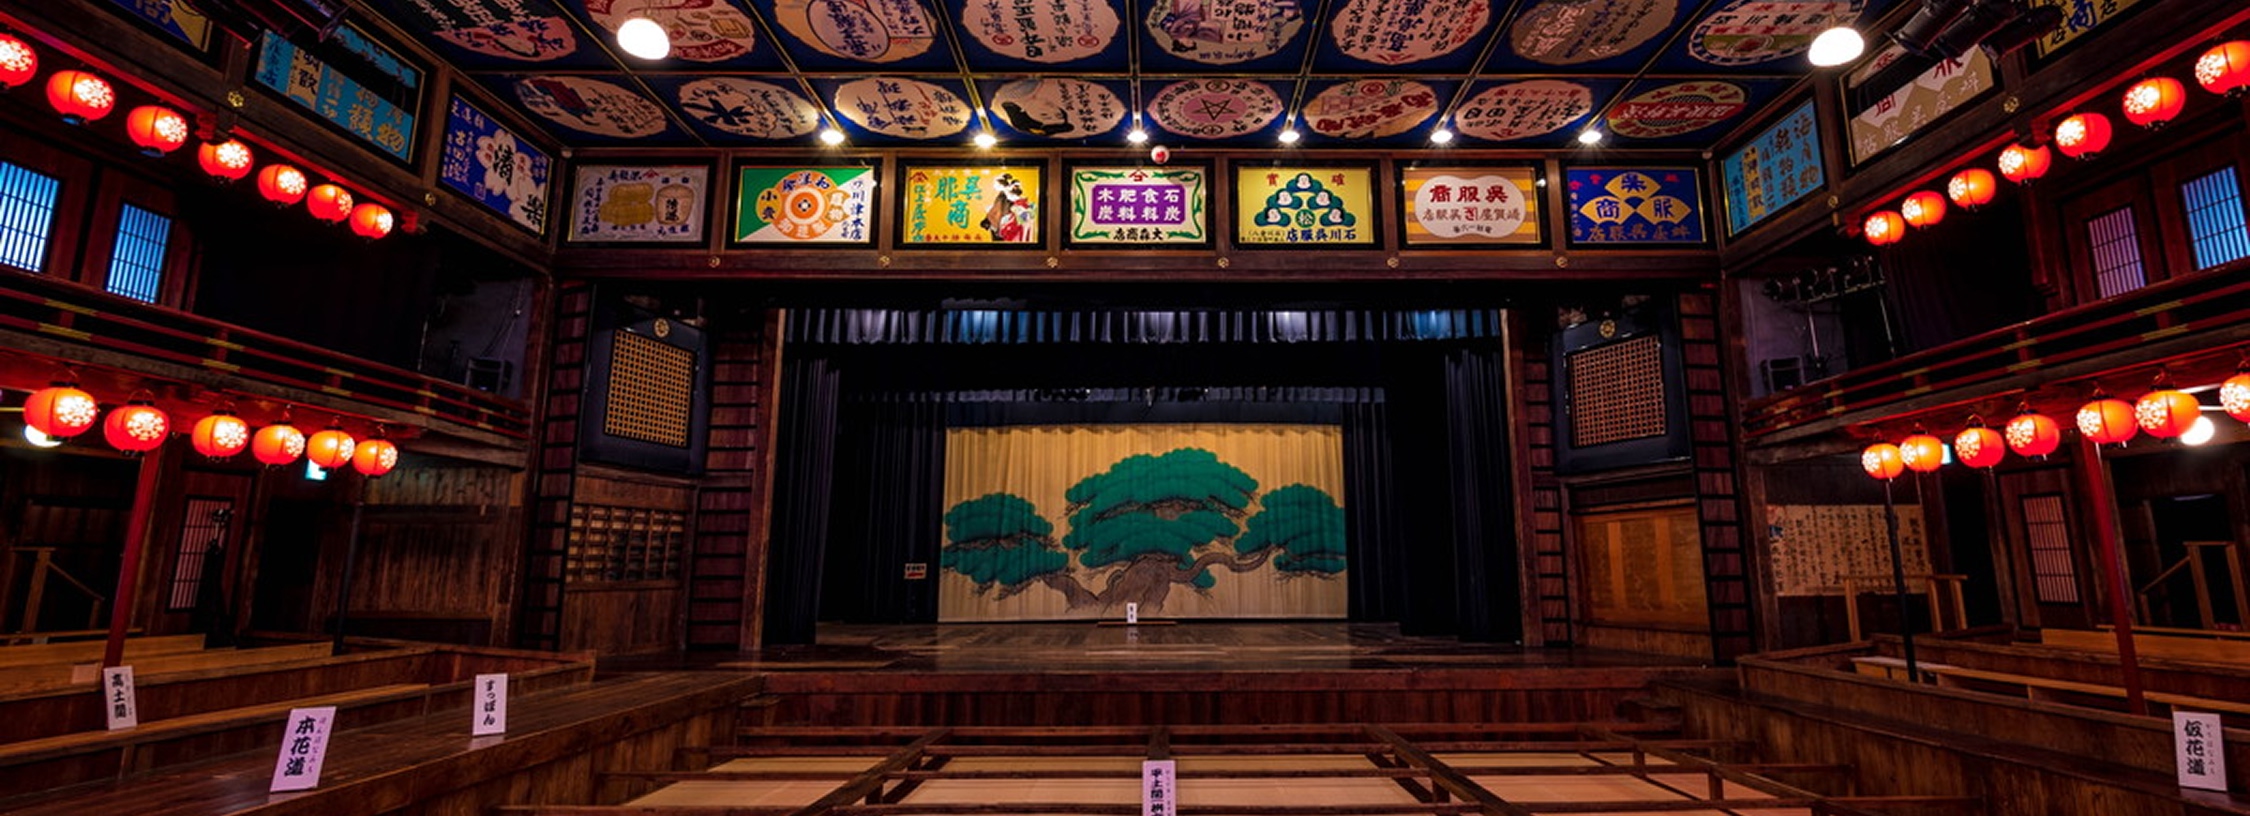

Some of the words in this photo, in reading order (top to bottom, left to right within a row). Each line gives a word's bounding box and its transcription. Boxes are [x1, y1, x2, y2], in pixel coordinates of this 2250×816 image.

[1429, 184, 1509, 203] 呉服商
[1297, 212, 1314, 226] 松
[111, 673, 127, 719] 高土間
[483, 679, 497, 726] すっぽん
[284, 715, 318, 777] 本花道
[2184, 719, 2206, 776] 仮花道
